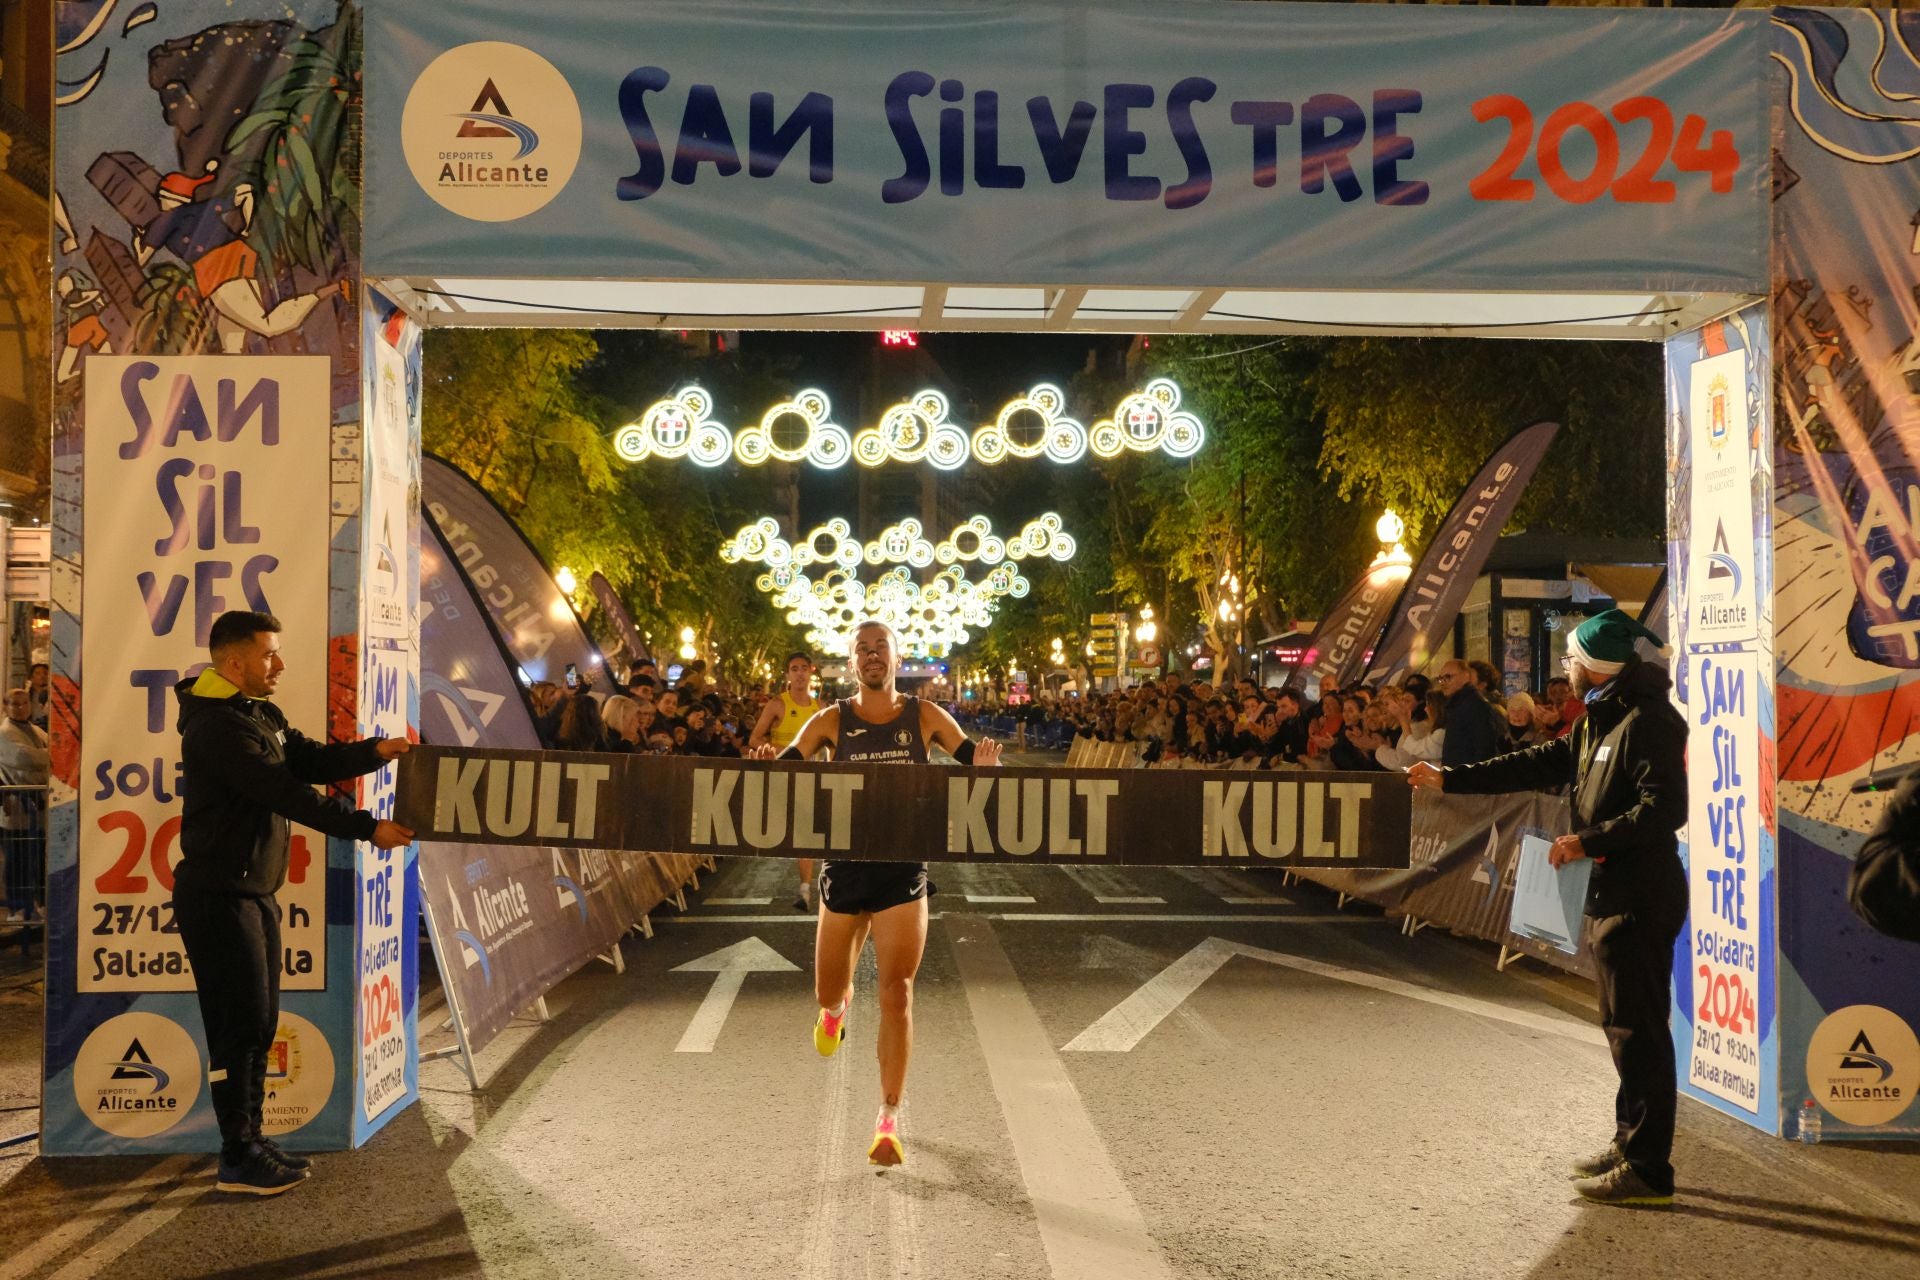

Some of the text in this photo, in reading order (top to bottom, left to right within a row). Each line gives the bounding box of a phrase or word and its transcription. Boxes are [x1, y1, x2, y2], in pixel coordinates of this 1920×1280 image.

[439, 151, 494, 160] DEPORTES
[616, 66, 834, 201] SAN
[1469, 94, 1740, 205] 2024
[439, 162, 549, 182] Alicante
[119, 361, 279, 460] SAN
[1407, 461, 1513, 632] Alicante
[1700, 604, 1747, 625] Alicante
[1700, 658, 1745, 725] SAN
[850, 749, 910, 761] CLUB ATLETISMO
[434, 757, 610, 840] KULT
[691, 768, 865, 850] KULT
[948, 777, 1120, 856] KULT
[1203, 780, 1372, 858] KULT
[1707, 795, 1746, 864] VES
[92, 901, 181, 935] 27/12
[367, 865, 393, 928] TRE
[473, 876, 530, 940] Alicante
[1706, 868, 1747, 931] TRE
[363, 974, 400, 1047] 2024
[1698, 964, 1756, 1035] 2024
[1696, 1025, 1721, 1055] 27/12
[98, 1095, 177, 1110] Alicante
[1722, 1069, 1755, 1099] Rambla
[1830, 1084, 1901, 1099] Alicante
[262, 1117, 302, 1126] LICANTE
